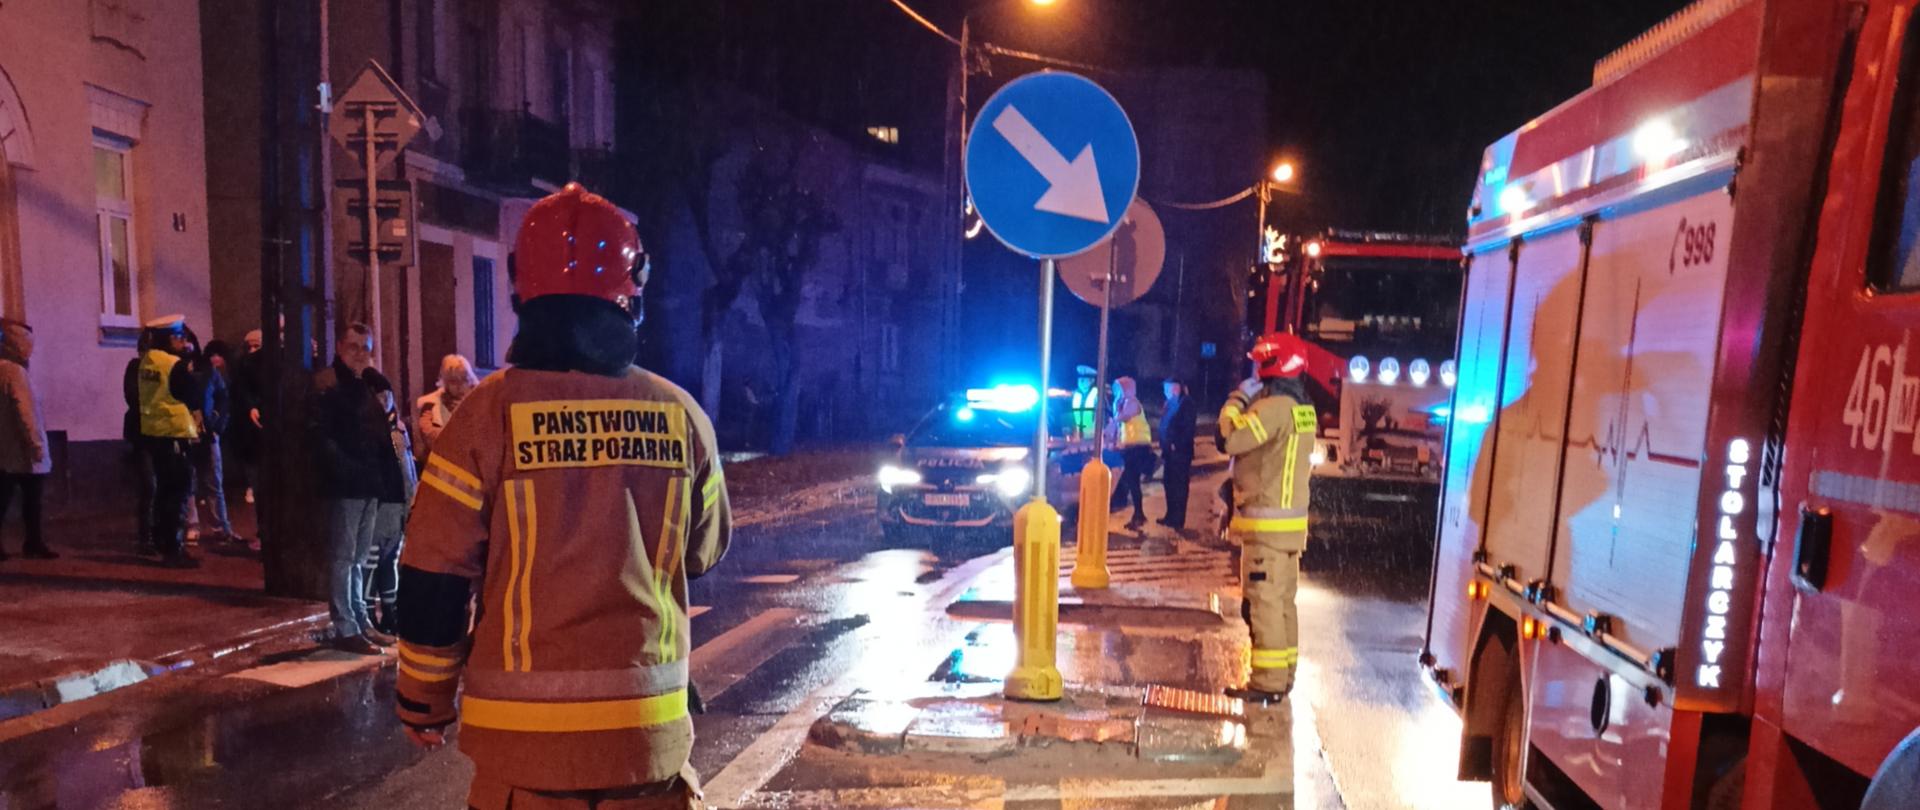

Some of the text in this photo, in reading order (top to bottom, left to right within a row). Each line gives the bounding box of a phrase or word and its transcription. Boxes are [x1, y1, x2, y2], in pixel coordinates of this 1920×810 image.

[1683, 221, 1716, 267] 998
[532, 405, 669, 435] PAŃSTWOWA
[518, 437, 684, 464] STRAŻ POŻARNA
[917, 457, 985, 469] POLICJA
[1696, 438, 1750, 688] STOLARCZYK
